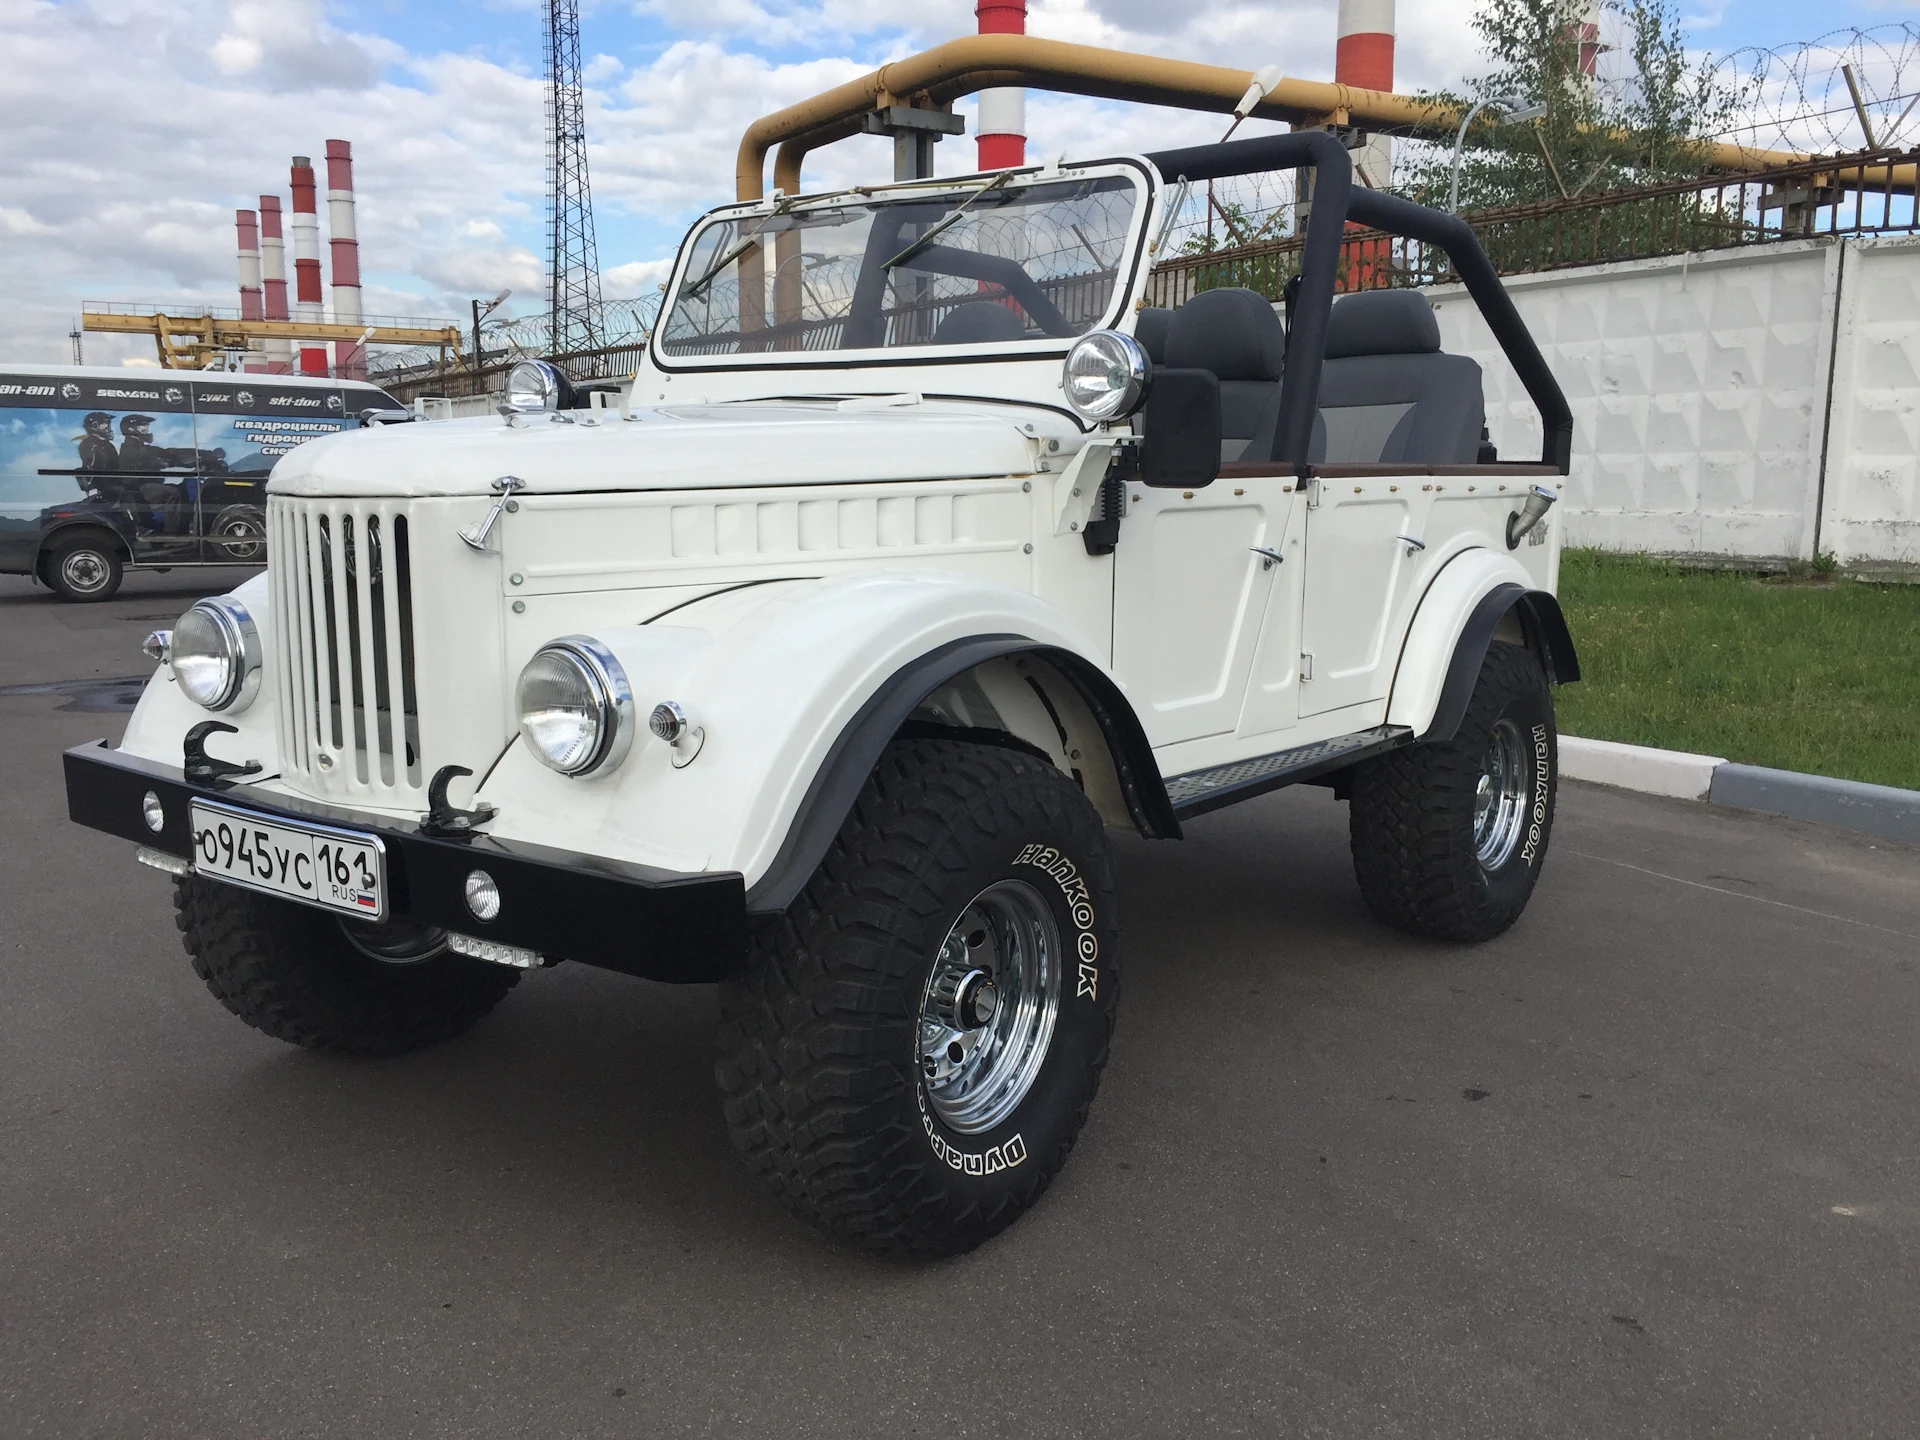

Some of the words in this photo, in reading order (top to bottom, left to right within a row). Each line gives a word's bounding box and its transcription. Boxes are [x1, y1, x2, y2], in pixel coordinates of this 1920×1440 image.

[0, 384, 56, 396] an-am
[234, 420, 341, 432] квадроциклы
[332, 884, 356, 902] RUS
